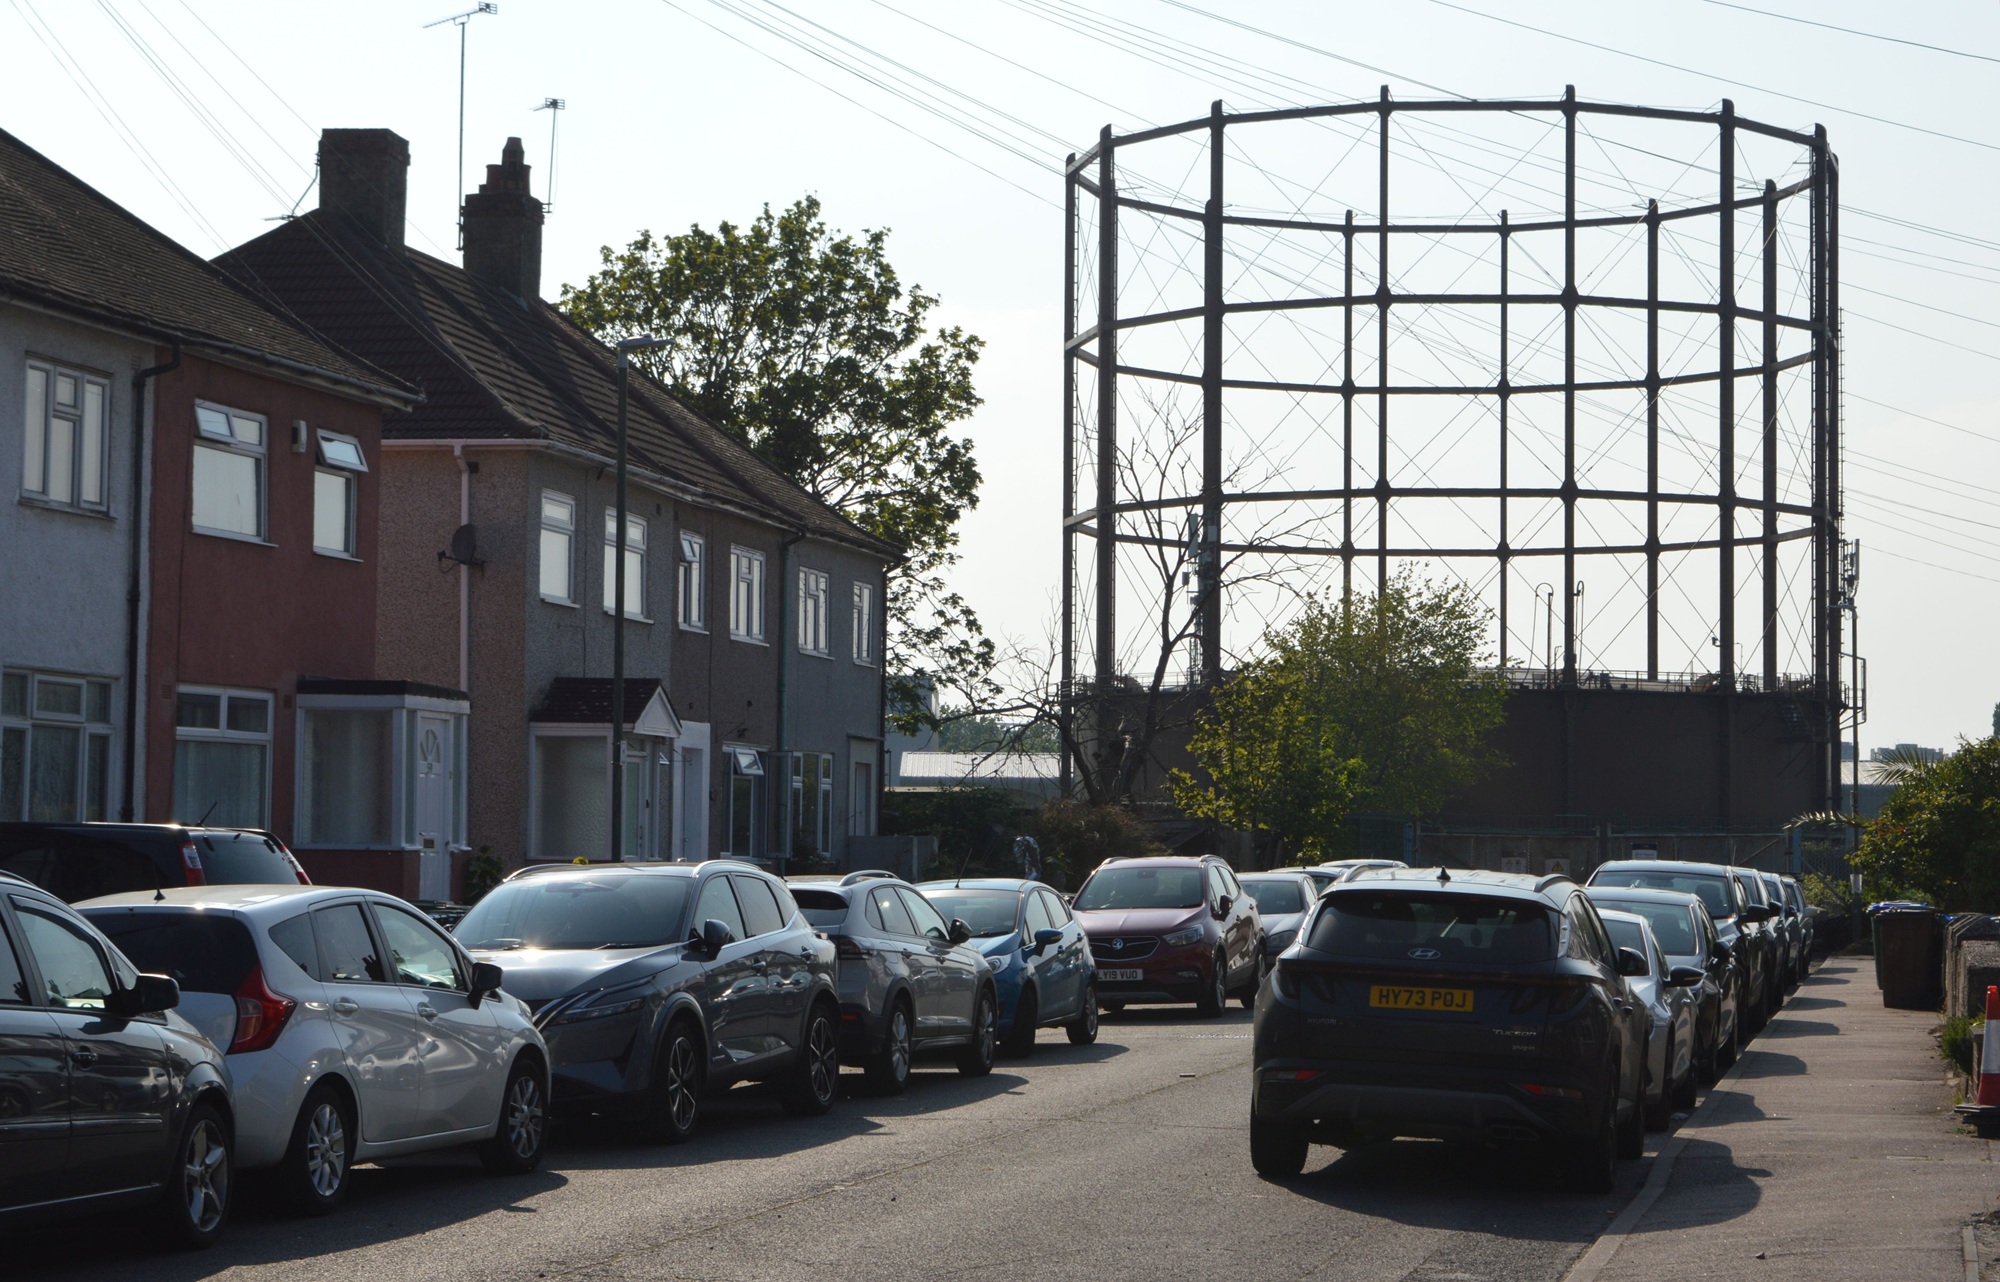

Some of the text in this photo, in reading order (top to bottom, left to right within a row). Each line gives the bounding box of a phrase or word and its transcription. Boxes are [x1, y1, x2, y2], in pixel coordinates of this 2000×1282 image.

[1096, 970, 1117, 980] LY19
[1379, 988, 1467, 1008] HY73 POJ
